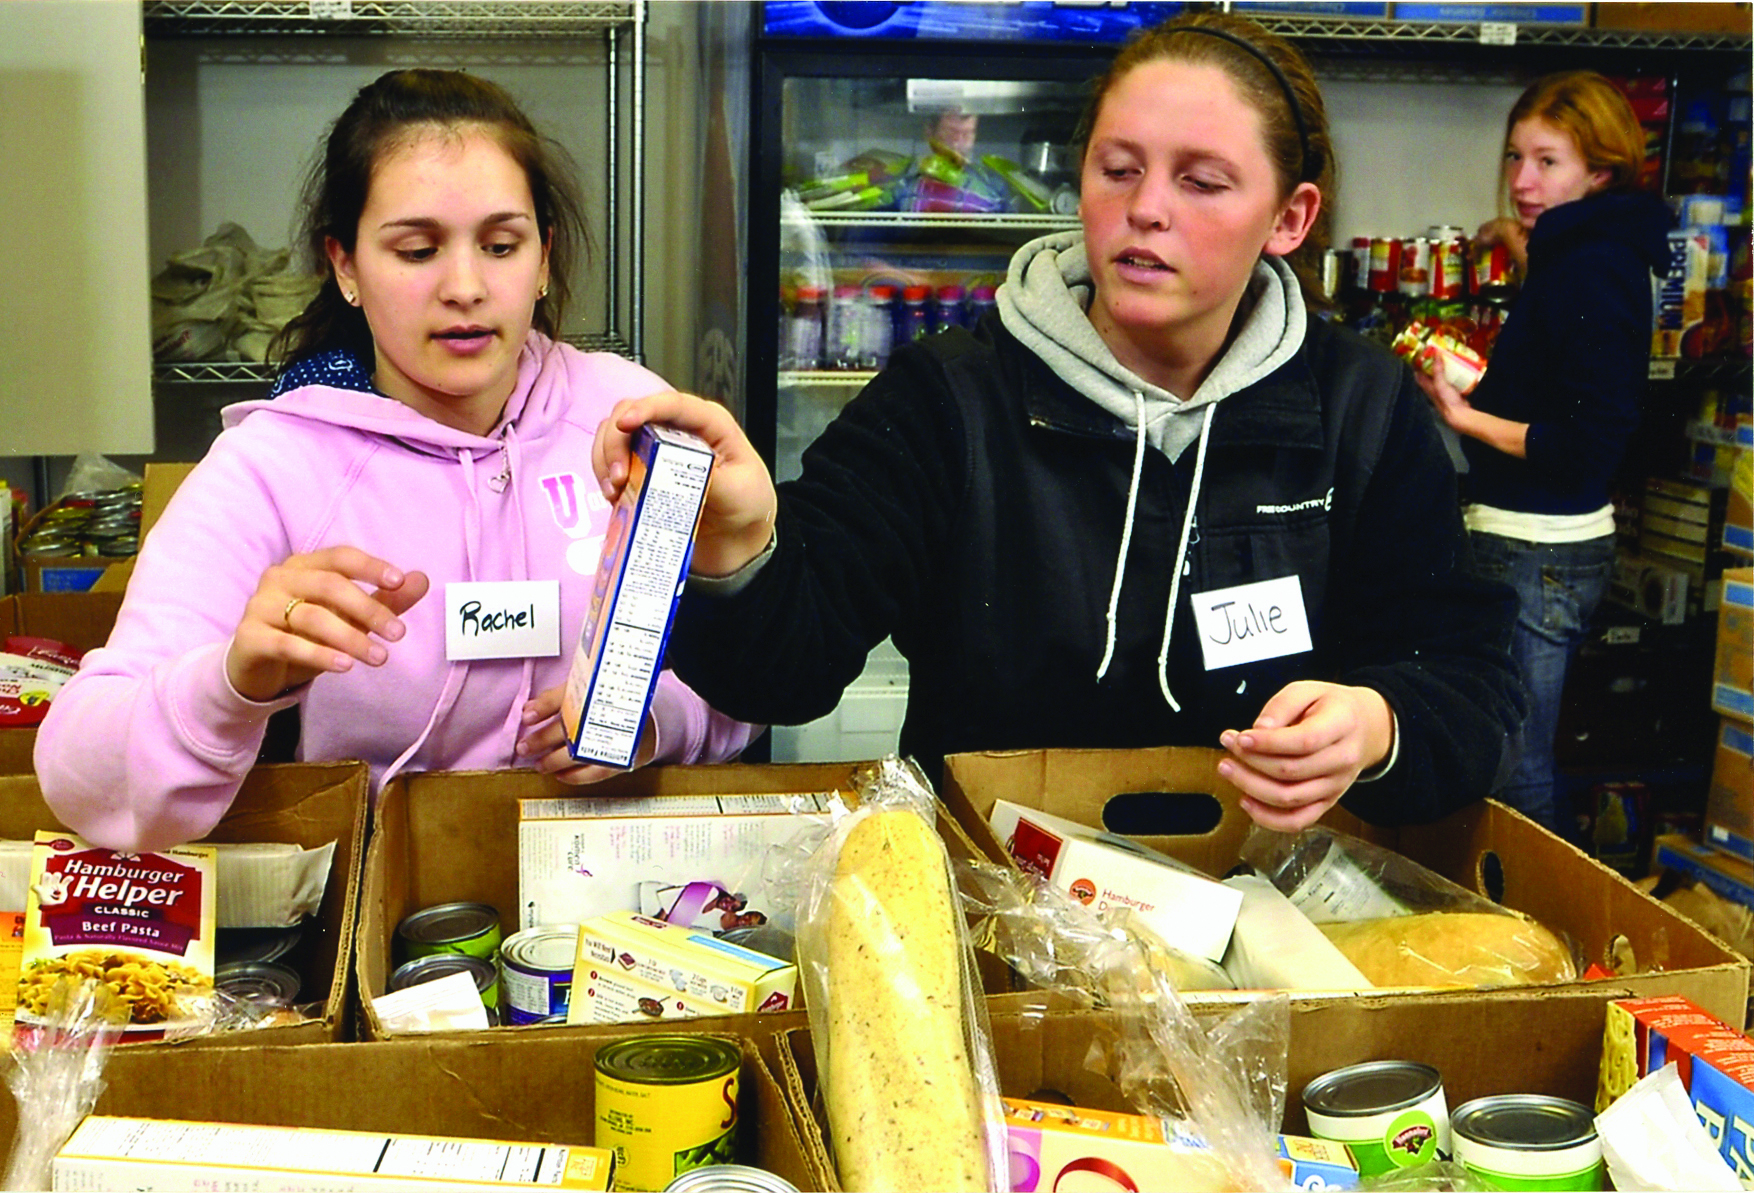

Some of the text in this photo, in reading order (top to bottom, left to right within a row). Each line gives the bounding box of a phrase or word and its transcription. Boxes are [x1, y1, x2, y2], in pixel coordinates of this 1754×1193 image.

[459, 600, 535, 637] Rachel
[1209, 600, 1288, 645] Julie
[64, 859, 185, 884] Hamburger
[73, 875, 184, 907] Helper
[1102, 888, 1155, 912] Hamburger
[94, 906, 150, 918] CLASSIC
[82, 921, 160, 938] Beef Pasta
